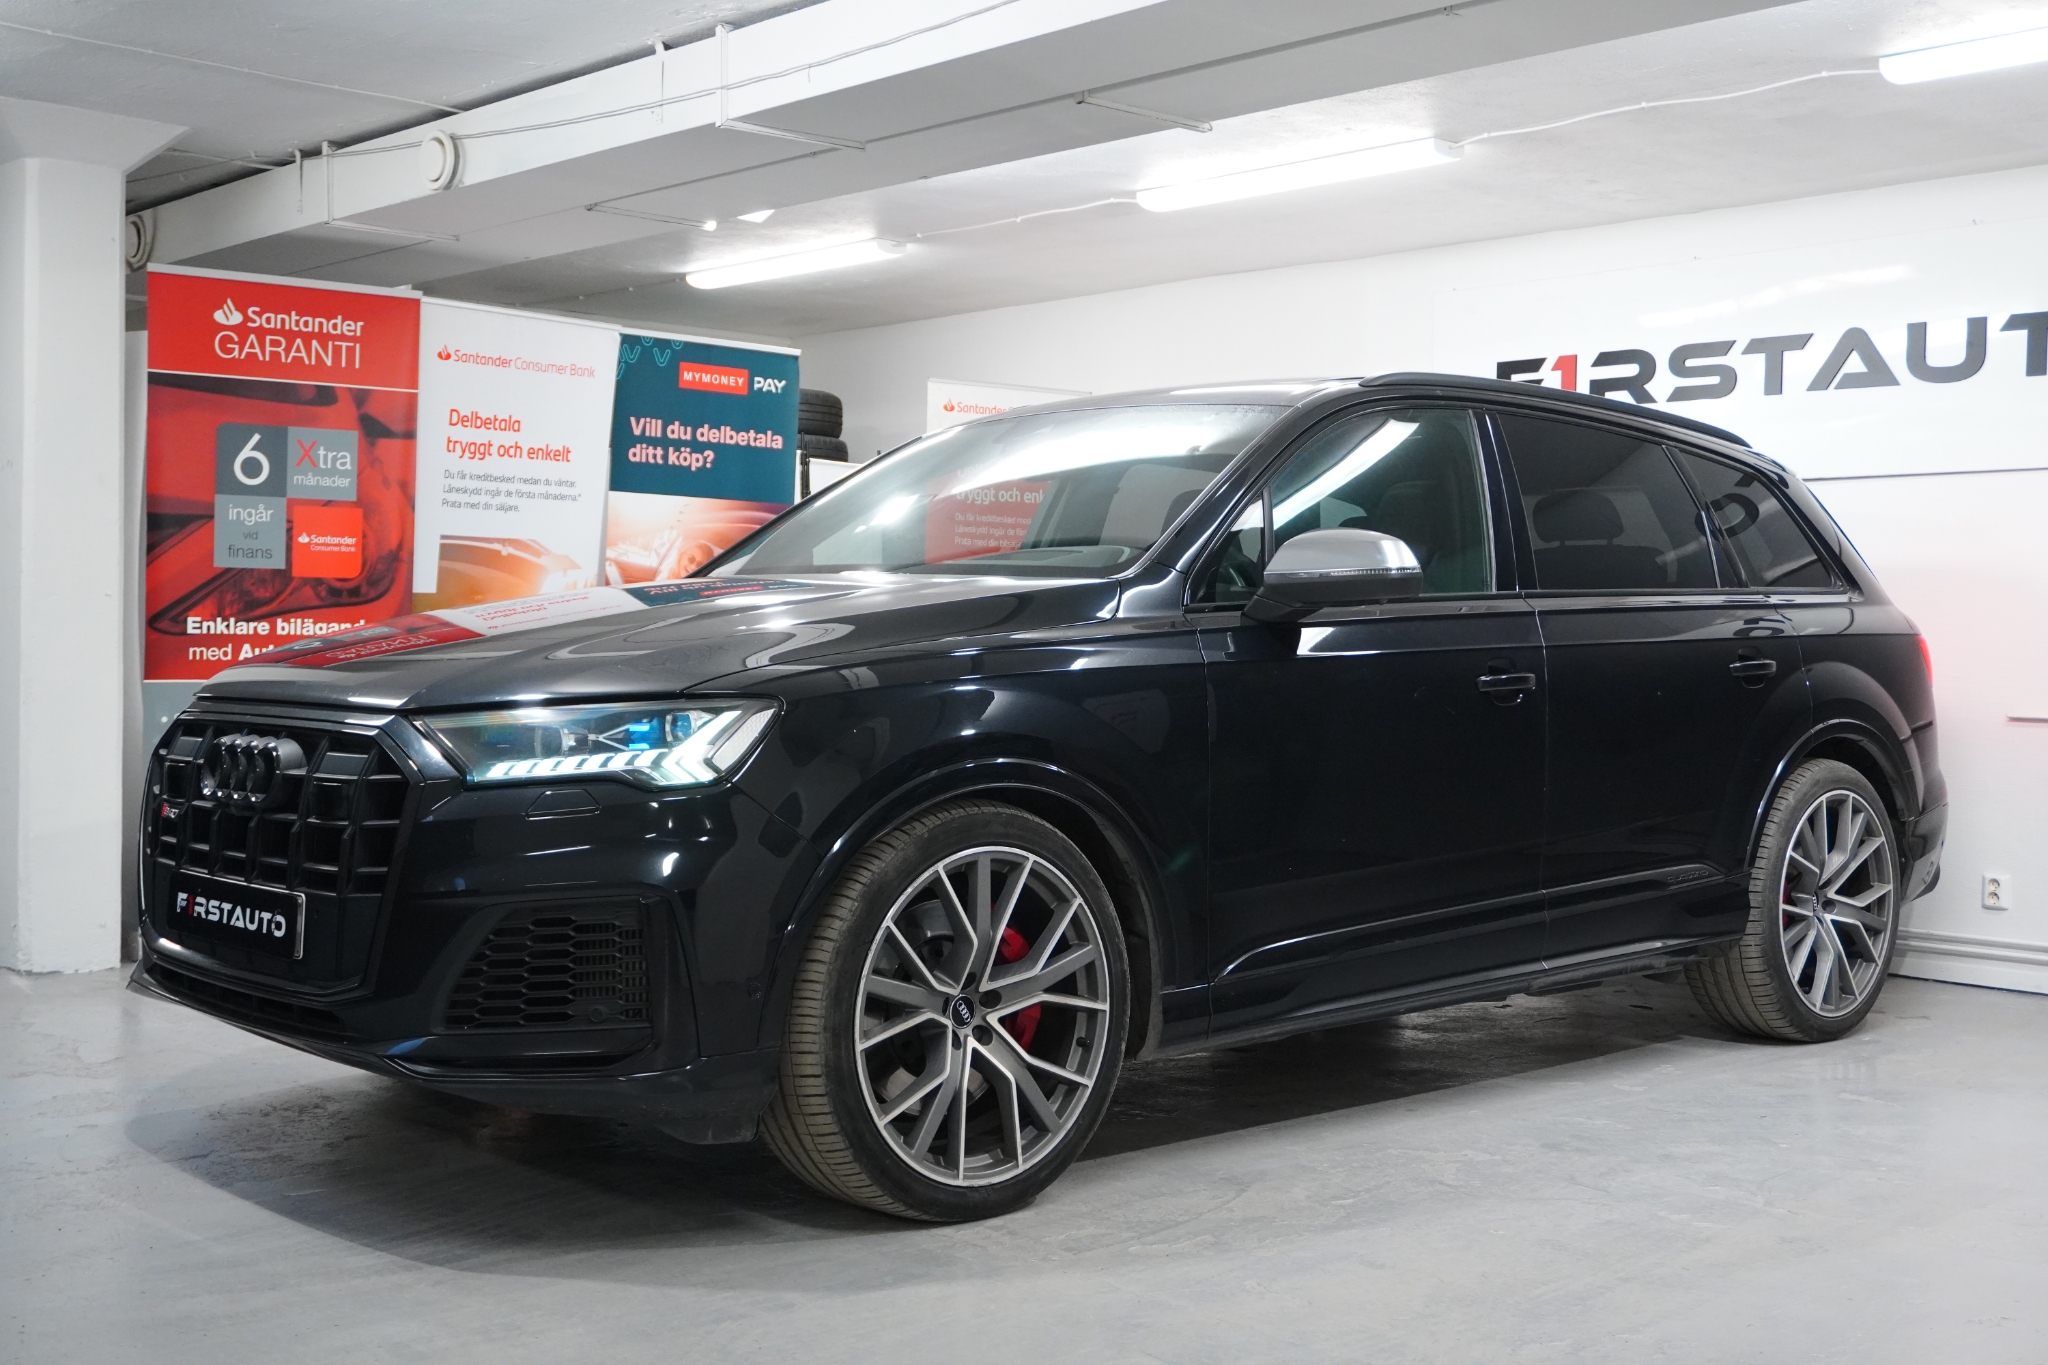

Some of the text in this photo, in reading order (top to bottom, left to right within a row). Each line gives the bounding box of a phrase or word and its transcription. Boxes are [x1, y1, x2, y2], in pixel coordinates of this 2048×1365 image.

[247, 307, 364, 336] Santander
[214, 331, 361, 369] GARANTI
[453, 349, 595, 378] Santander Consumer Bank
[683, 370, 745, 387] MYMONEY
[753, 376, 787, 394] PAY
[956, 402, 1007, 415] Santander
[448, 408, 521, 433] Delbetala
[629, 416, 784, 449] Vill du delbetala
[446, 436, 572, 463] tryggt och enkelt
[627, 443, 715, 472] ditt köp?
[233, 432, 352, 486] 6 Xtra
[293, 473, 351, 488] månader
[443, 469, 455, 480] Du
[456, 470, 468, 481] får
[469, 472, 516, 484] kreditbesked
[516, 476, 542, 486] medan
[543, 477, 553, 487] du
[443, 484, 483, 497] Låneskydd
[484, 486, 503, 499] ingår
[504, 488, 514, 498] de
[515, 488, 536, 500] första
[998, 487, 1021, 502] och
[441, 498, 462, 509] Prata
[463, 500, 480, 510] med
[482, 501, 494, 511] din
[228, 504, 275, 526] ingår
[242, 530, 259, 541] vid
[310, 534, 357, 545] Santander
[228, 544, 273, 560] finans
[340, 545, 356, 553] Bank
[186, 616, 271, 635] Enklare
[188, 643, 233, 661] med
[176, 891, 287, 938] F1RSTAUTO
